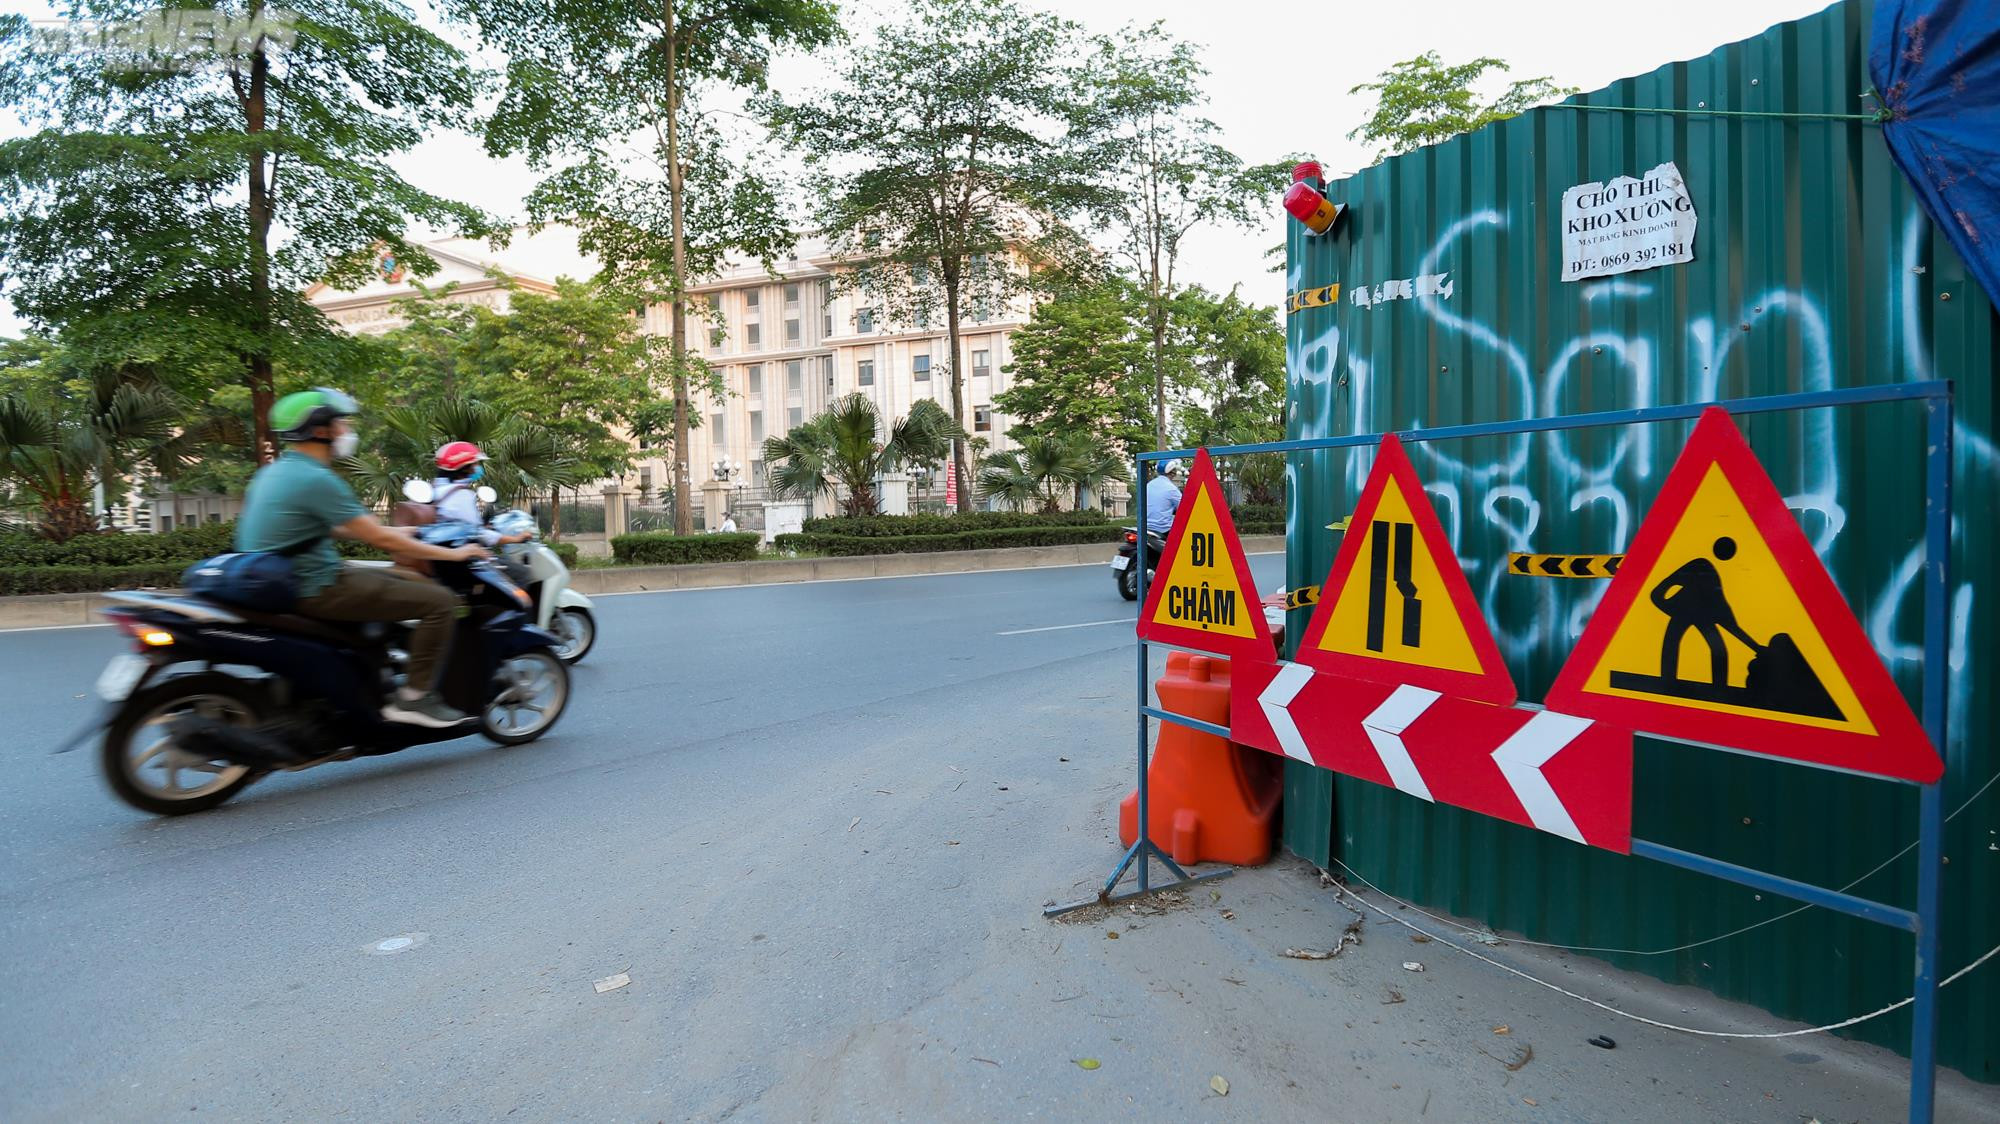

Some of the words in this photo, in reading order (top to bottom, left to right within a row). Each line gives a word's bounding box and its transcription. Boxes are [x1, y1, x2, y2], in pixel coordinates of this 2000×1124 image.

[1577, 187, 1618, 210] CHO
[1623, 177, 1668, 198] THU
[1568, 212, 1612, 235] KHO
[1622, 226, 1646, 237] KINH
[1601, 251, 1630, 269] 0869
[1634, 246, 1657, 263] 392
[1661, 242, 1685, 257] 181
[1191, 532, 1215, 568] ĐI
[1168, 581, 1236, 630] CHẬM
